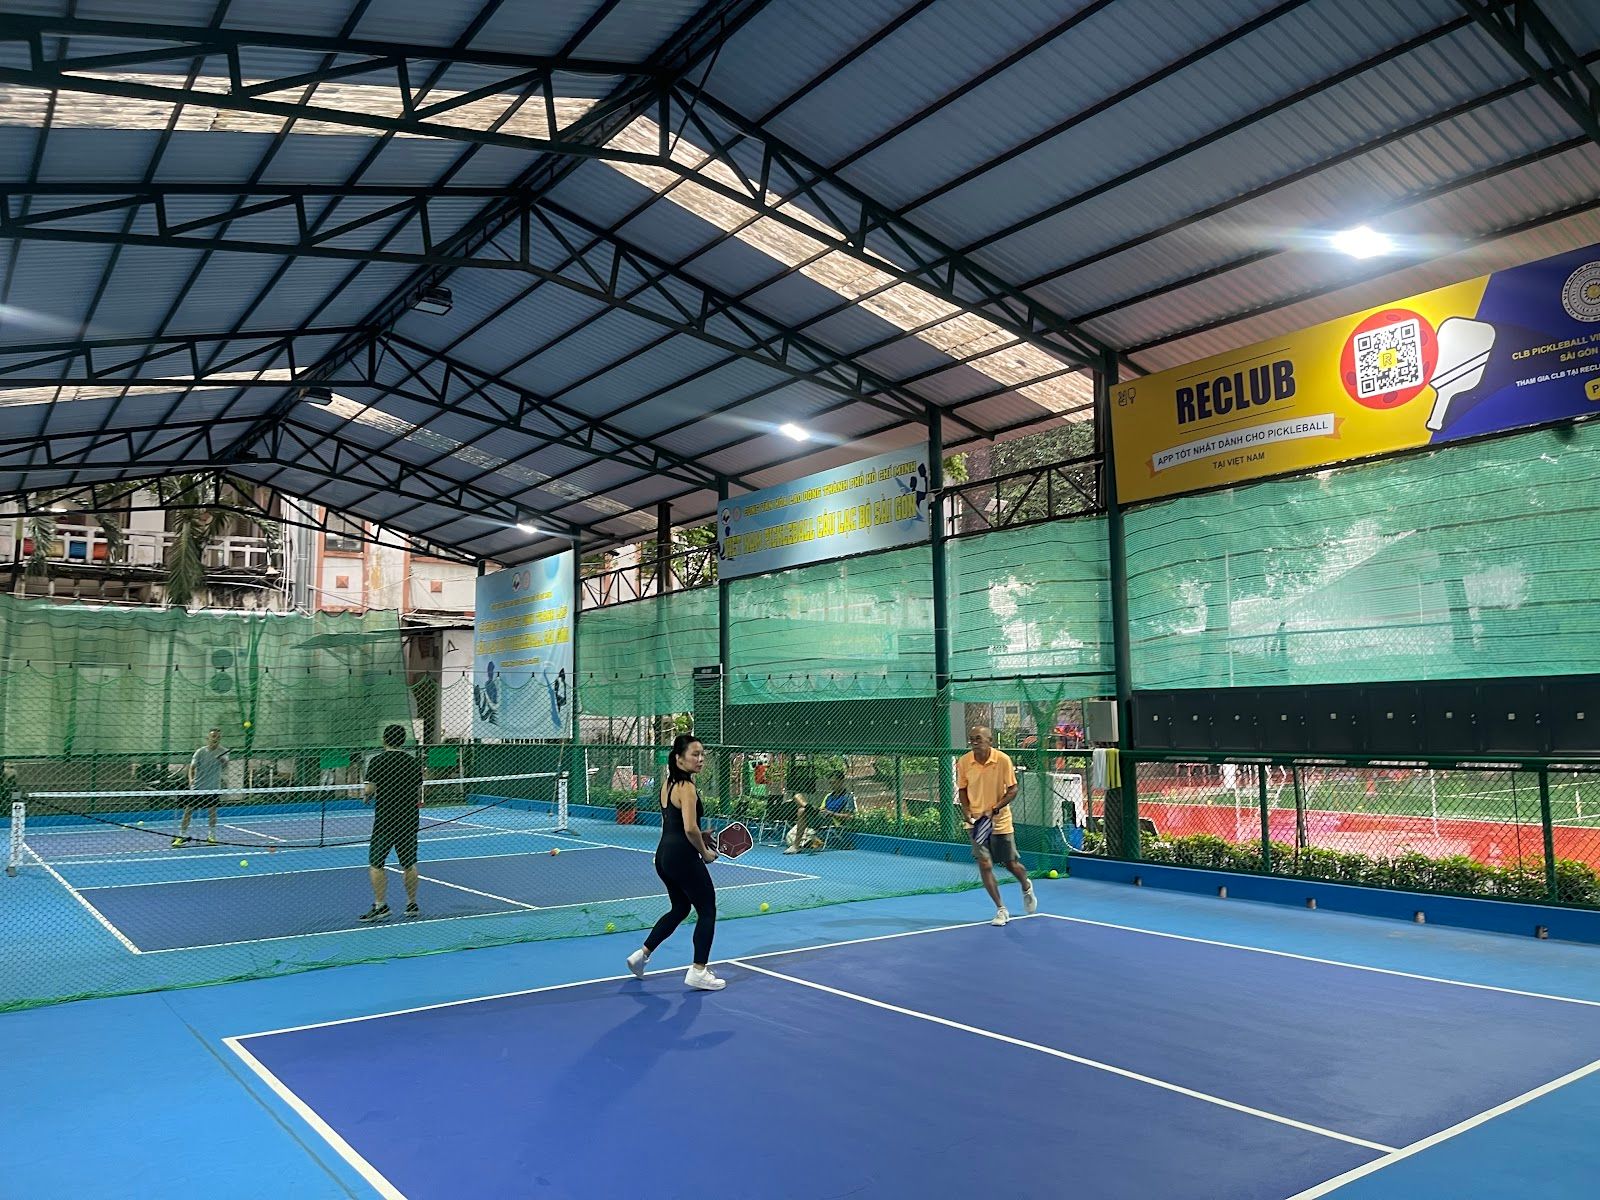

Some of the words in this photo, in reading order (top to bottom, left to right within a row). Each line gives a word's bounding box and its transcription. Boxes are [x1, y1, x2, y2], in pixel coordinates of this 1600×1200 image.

[1511, 349, 1530, 361] CLB
[1532, 337, 1588, 356] PICKLEBALL
[1560, 352, 1576, 362] SÀI
[1176, 360, 1296, 424] RECLUB
[1515, 378, 1536, 388] THAM
[1537, 375, 1550, 383] GIA
[1550, 370, 1566, 380] CLB
[1566, 369, 1579, 377] TẠI
[1157, 455, 1174, 466] APP
[1218, 434, 1244, 449] DÀNH
[1245, 430, 1266, 442] CHO
[1267, 421, 1329, 438] PICKLEBALL
[1212, 459, 1226, 470] TẠI
[1228, 454, 1246, 467] VIỆT
[1246, 452, 1266, 463] NAM
[822, 475, 848, 496] THÀNH
[878, 465, 891, 482] CHÍ
[893, 460, 916, 478] MINH
[874, 492, 892, 525] SÀI
